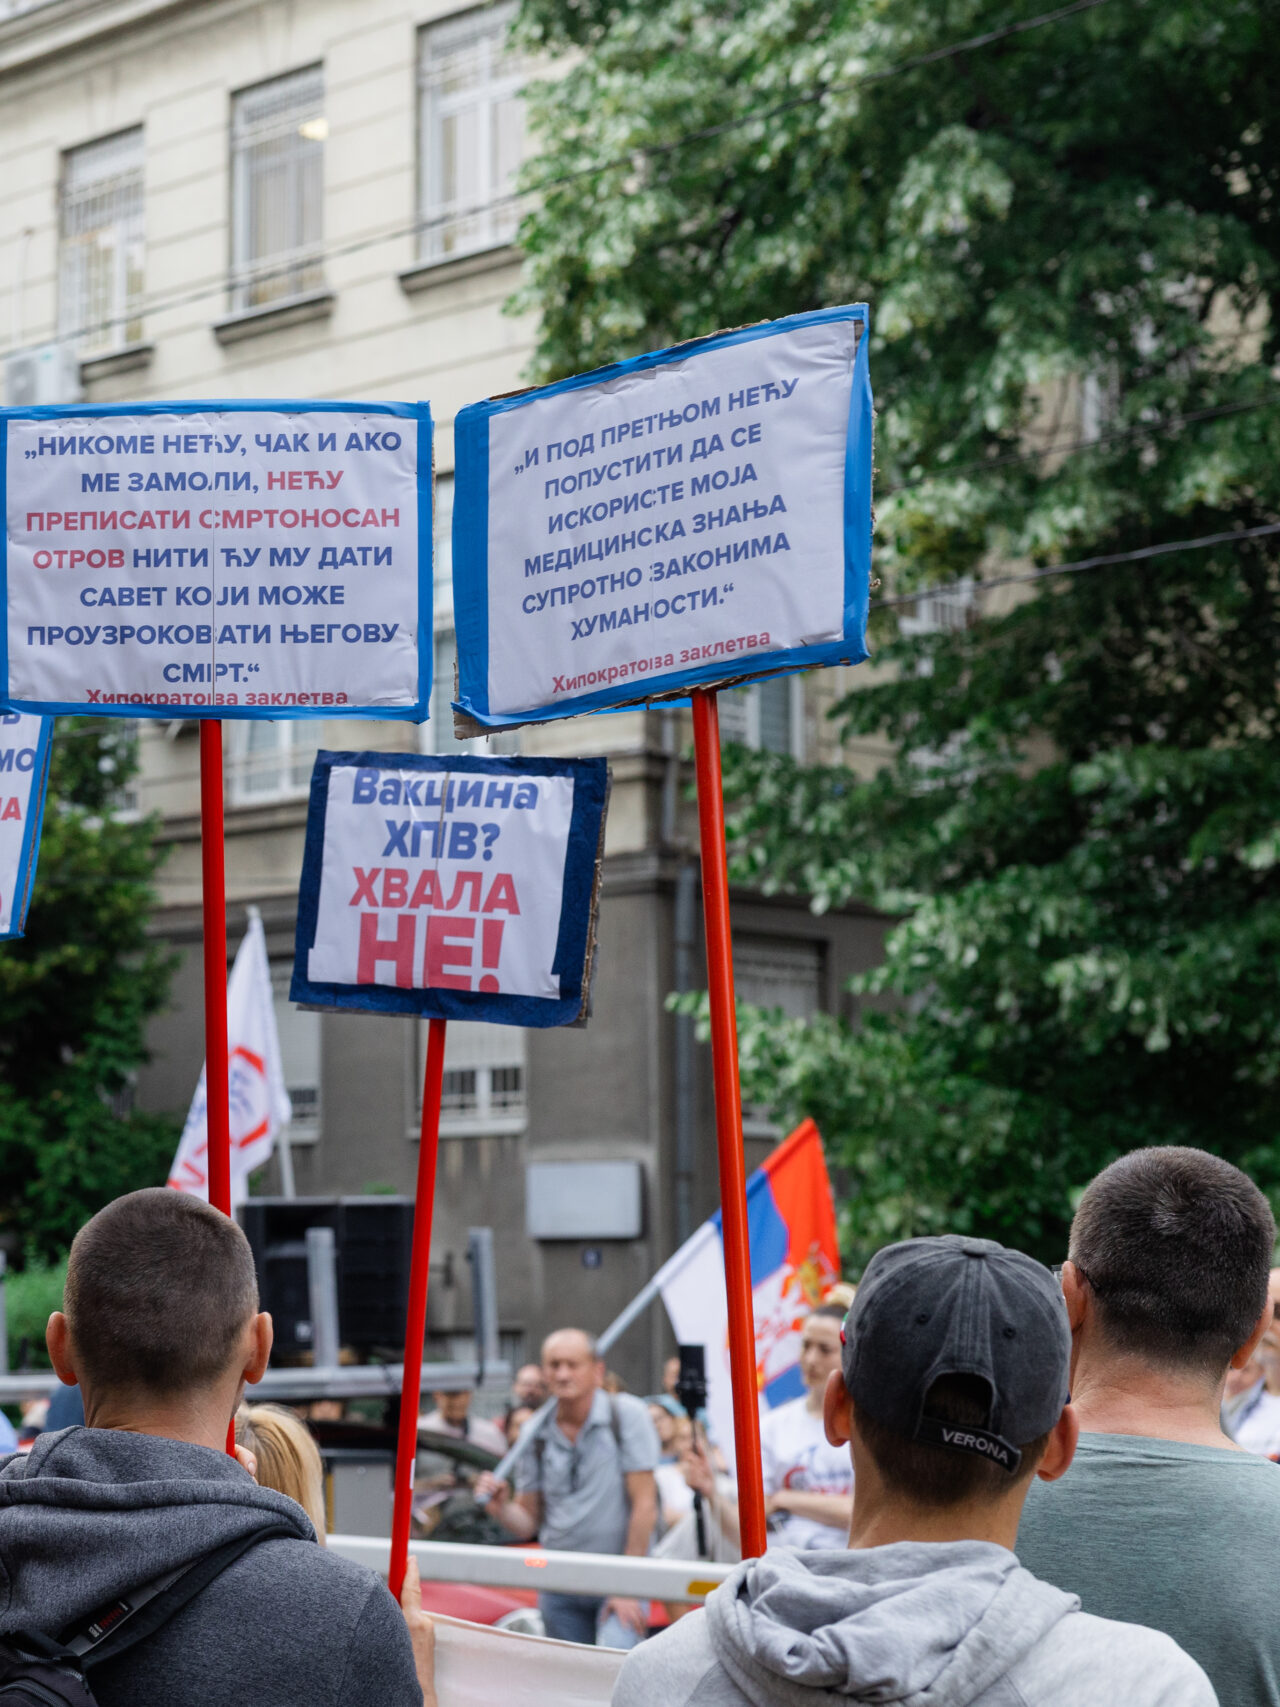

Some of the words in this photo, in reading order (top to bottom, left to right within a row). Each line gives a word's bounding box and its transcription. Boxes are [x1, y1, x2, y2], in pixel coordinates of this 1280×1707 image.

[546, 436, 595, 465] ПОД
[601, 402, 721, 448] ПРЕТЊОМ
[728, 378, 800, 411] НЕЋУ
[24, 434, 155, 459] „НИКОМЕ
[255, 432, 310, 453] ЧАК
[317, 432, 337, 452] И
[345, 431, 402, 452] АКО
[544, 448, 684, 499] ПОПУСТИТИ
[689, 434, 724, 461] ДА
[731, 422, 762, 448] СЕ
[81, 472, 120, 492] МЕ
[127, 471, 259, 493] ЗАМОЛИ,
[267, 470, 344, 490] НЕЋУ
[547, 484, 684, 535] ИСКОРИСТЕ
[690, 463, 758, 497] МОЈА
[26, 510, 191, 532] ПРЕПИСАТИ
[199, 508, 401, 530] СМРТОНОСАН
[524, 519, 686, 578] МЕДИЦИНСКА
[692, 494, 788, 534] ЗНАЊА
[32, 549, 125, 570] ОТРОВ
[133, 548, 209, 568] НИТИ
[220, 547, 261, 568] ЋУ
[269, 546, 310, 567] МУ
[318, 546, 394, 570] ДАТИ
[521, 565, 643, 615] СУПРОТНО
[649, 532, 791, 583] ЗАКОНИМА
[80, 586, 167, 607] САВЕТ
[175, 585, 250, 606] КОЈИ
[258, 585, 345, 605] МОЖЕ
[27, 624, 271, 646] ПРОУЗРОКОВАТИ
[280, 623, 400, 644] ЊЕГОВУ
[551, 652, 675, 694] Хипократова
[679, 631, 771, 665] заклетва
[85, 689, 239, 706] Хипократова
[245, 690, 348, 706] заклетва
[352, 768, 539, 813] Вакцина
[382, 820, 501, 861] ХПВ?
[349, 866, 521, 915] ХВАЛА
[357, 912, 506, 993] НЕ!
[941, 1427, 1009, 1465] VERONA
